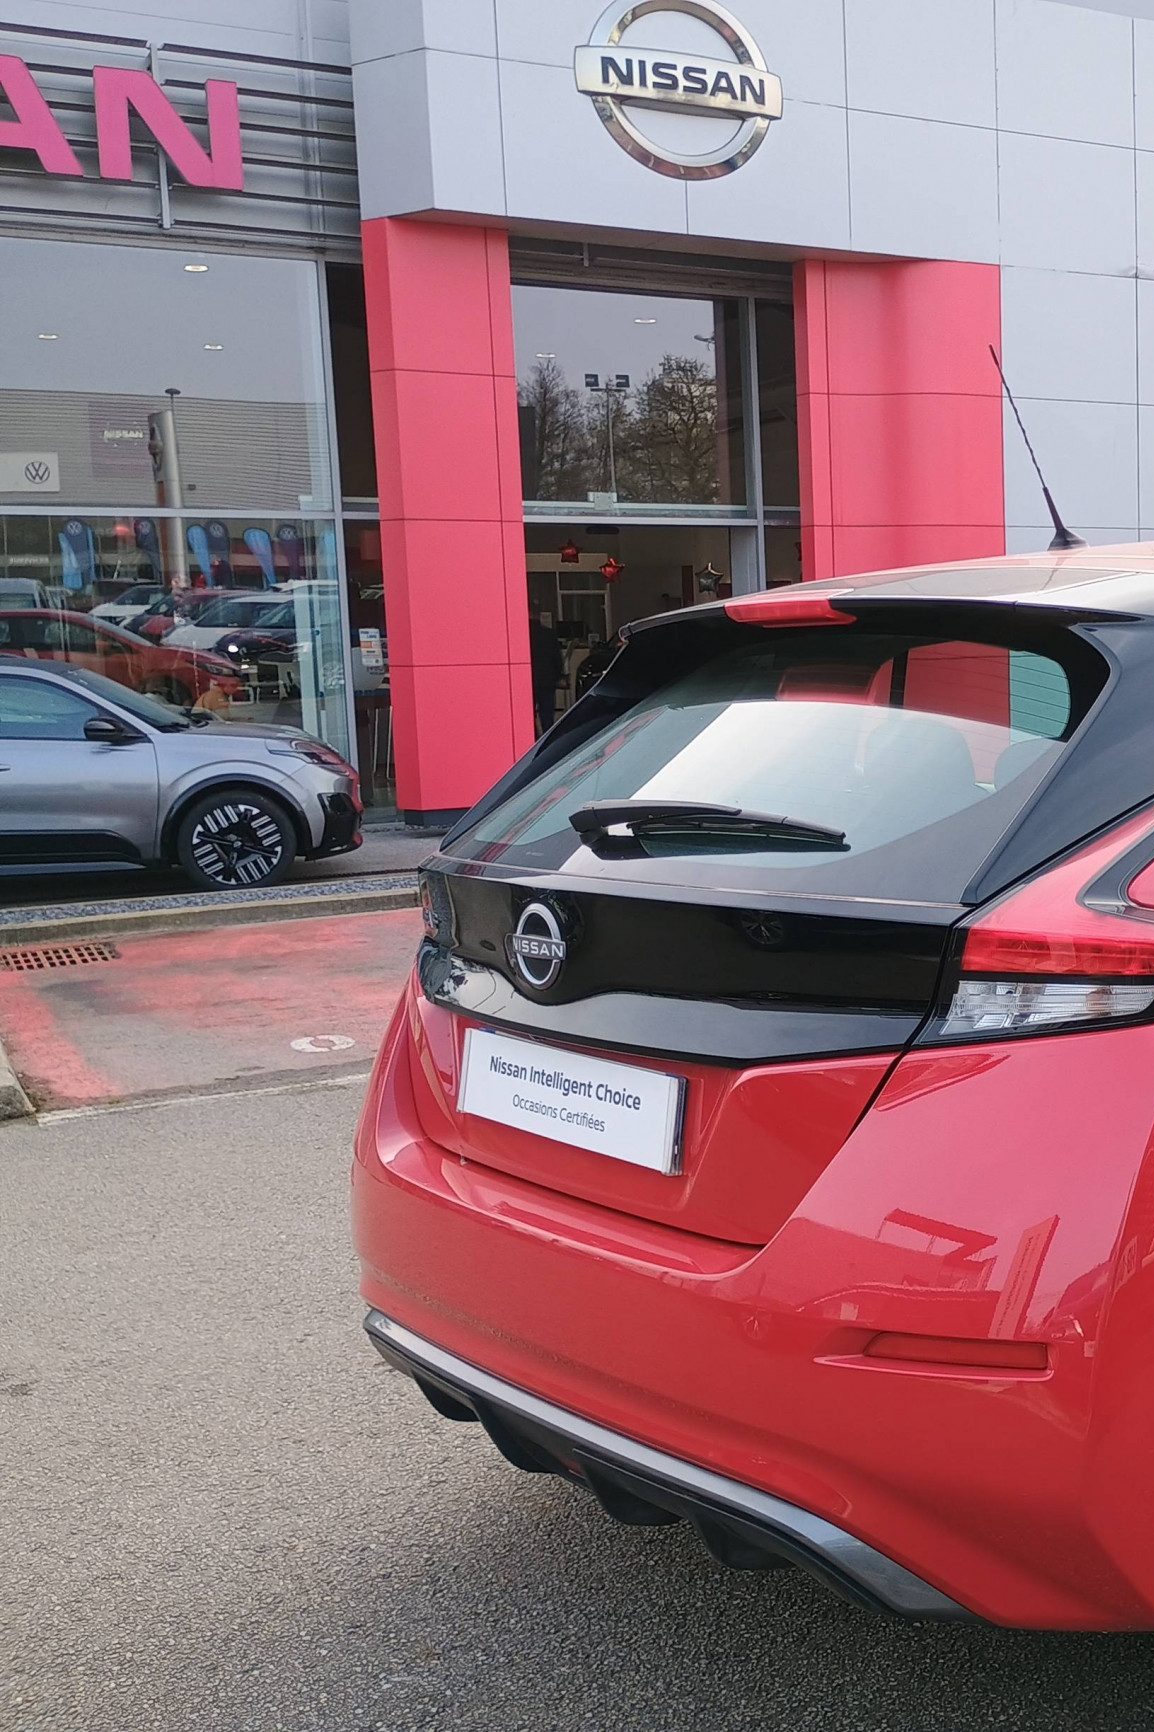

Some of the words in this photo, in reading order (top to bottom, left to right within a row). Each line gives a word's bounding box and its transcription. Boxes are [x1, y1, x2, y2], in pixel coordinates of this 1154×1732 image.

[600, 56, 766, 105] NISSAN
[513, 936, 564, 958] NISSAN
[490, 1056, 527, 1080] Nissan
[530, 1066, 593, 1097] Intelligent
[596, 1084, 641, 1110] Choice
[512, 1094, 558, 1119] Occasions
[559, 1107, 606, 1132] Certifiées
